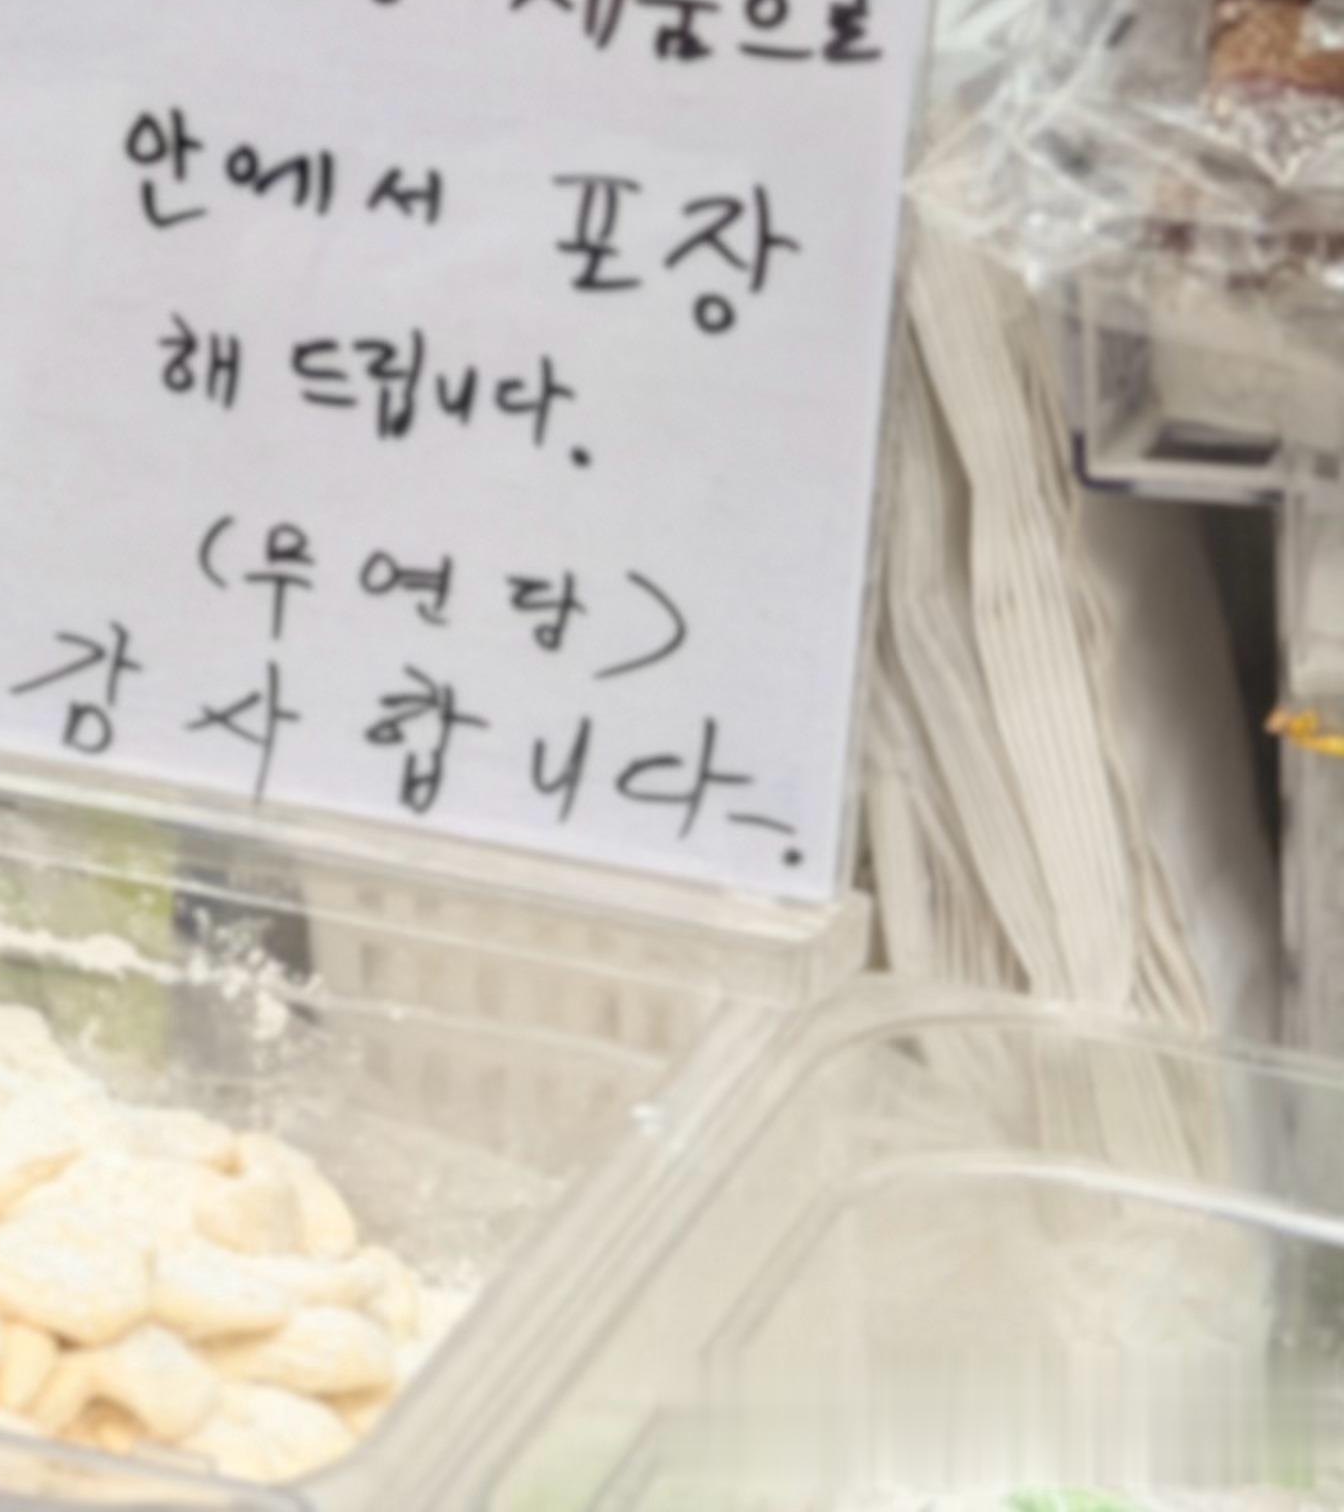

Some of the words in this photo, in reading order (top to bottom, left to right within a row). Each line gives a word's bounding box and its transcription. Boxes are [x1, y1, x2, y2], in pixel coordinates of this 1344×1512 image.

[123, 107, 444, 230] 안에서
[553, 176, 801, 335] 포장
[159, 315, 241, 410] 해
